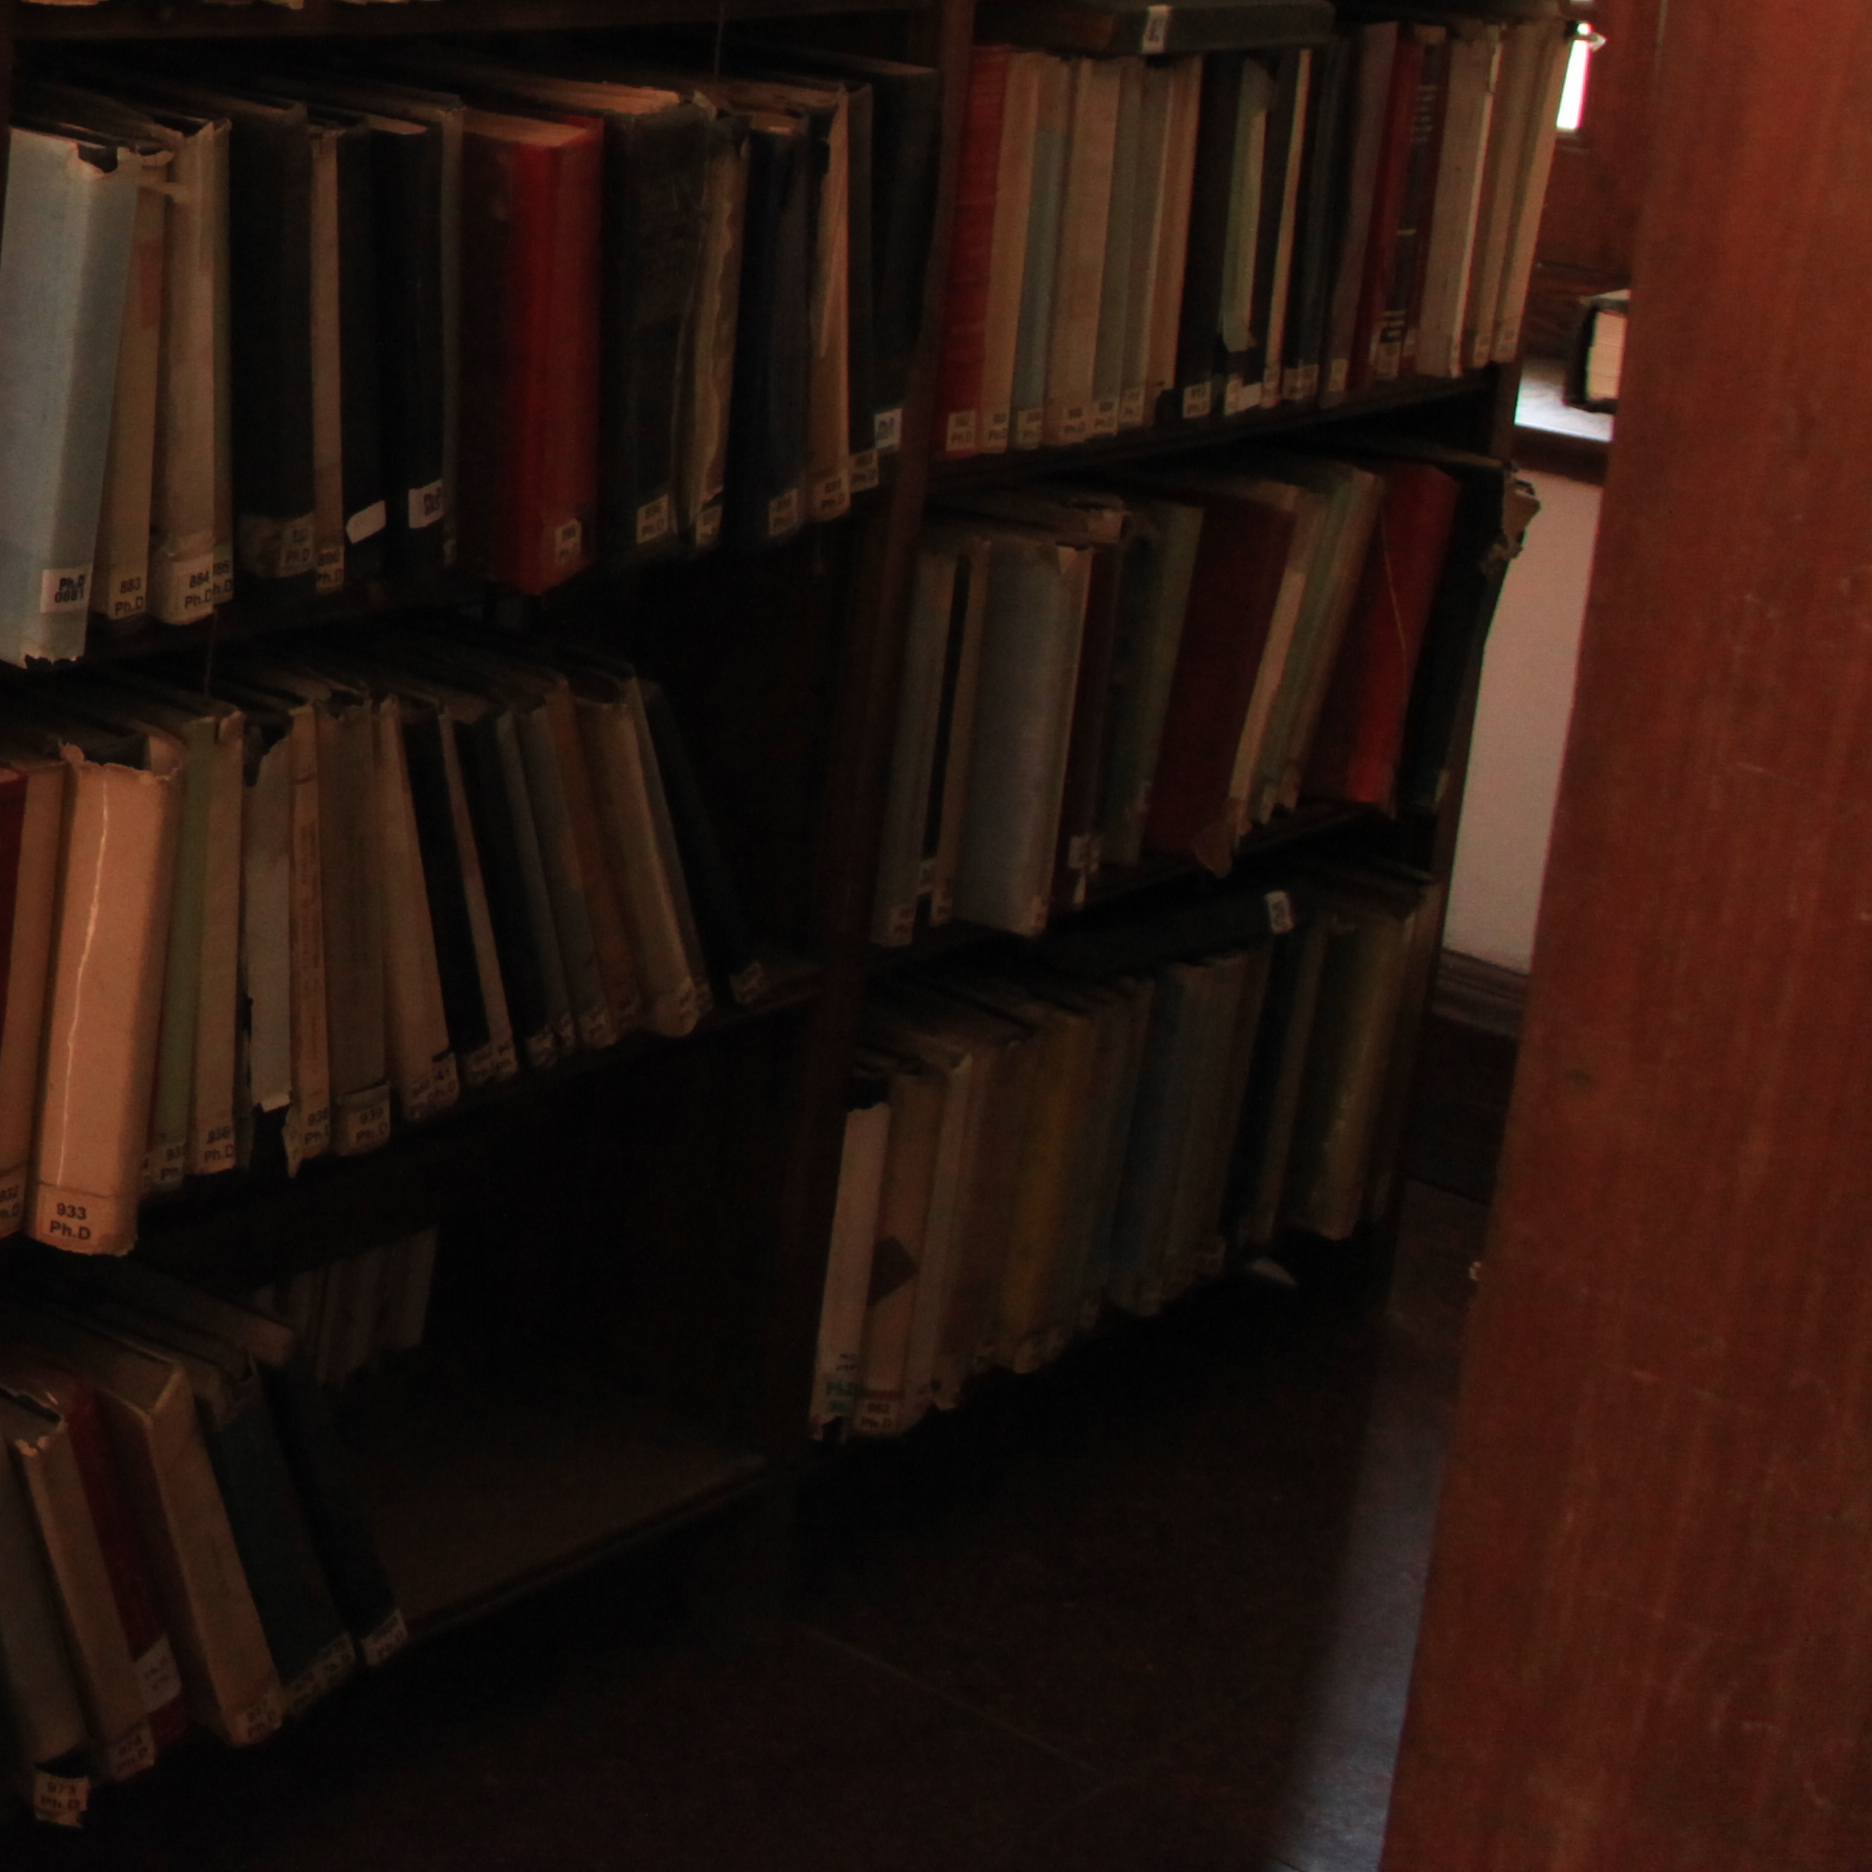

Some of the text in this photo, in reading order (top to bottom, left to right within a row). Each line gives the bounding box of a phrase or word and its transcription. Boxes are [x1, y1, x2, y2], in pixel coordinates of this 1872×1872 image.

[120, 578, 141, 593] 883
[189, 570, 210, 588] 884
[115, 597, 145, 614] Ph.D
[184, 591, 213, 610] Ph.D
[56, 1202, 87, 1220] 933
[49, 1220, 92, 1241] Ph.D
